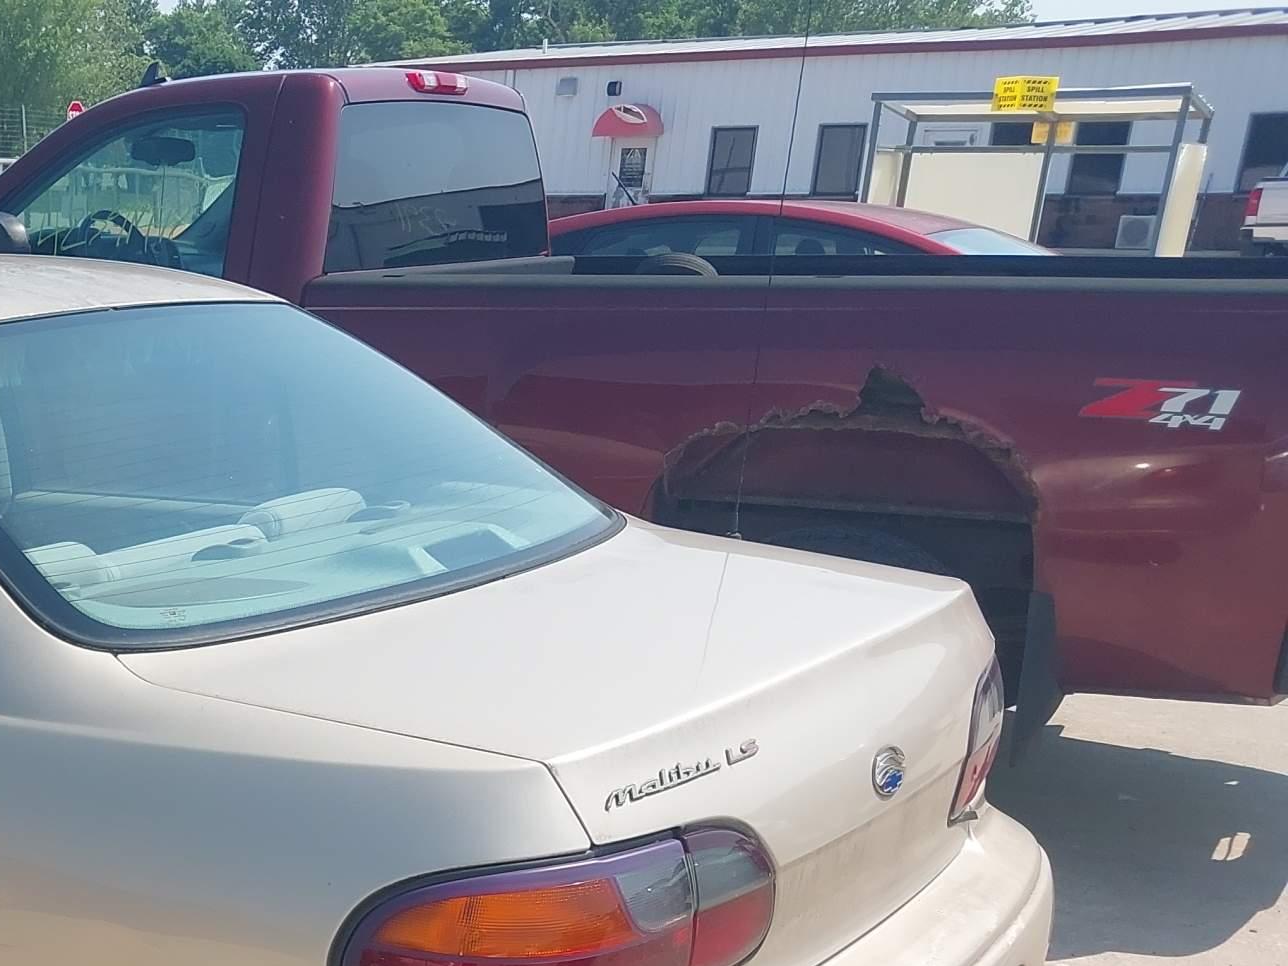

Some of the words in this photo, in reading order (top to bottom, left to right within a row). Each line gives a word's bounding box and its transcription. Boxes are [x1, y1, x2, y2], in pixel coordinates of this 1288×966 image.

[1079, 377, 1242, 418] Z71
[604, 761, 722, 812] Malibu
[725, 738, 760, 767] LS
